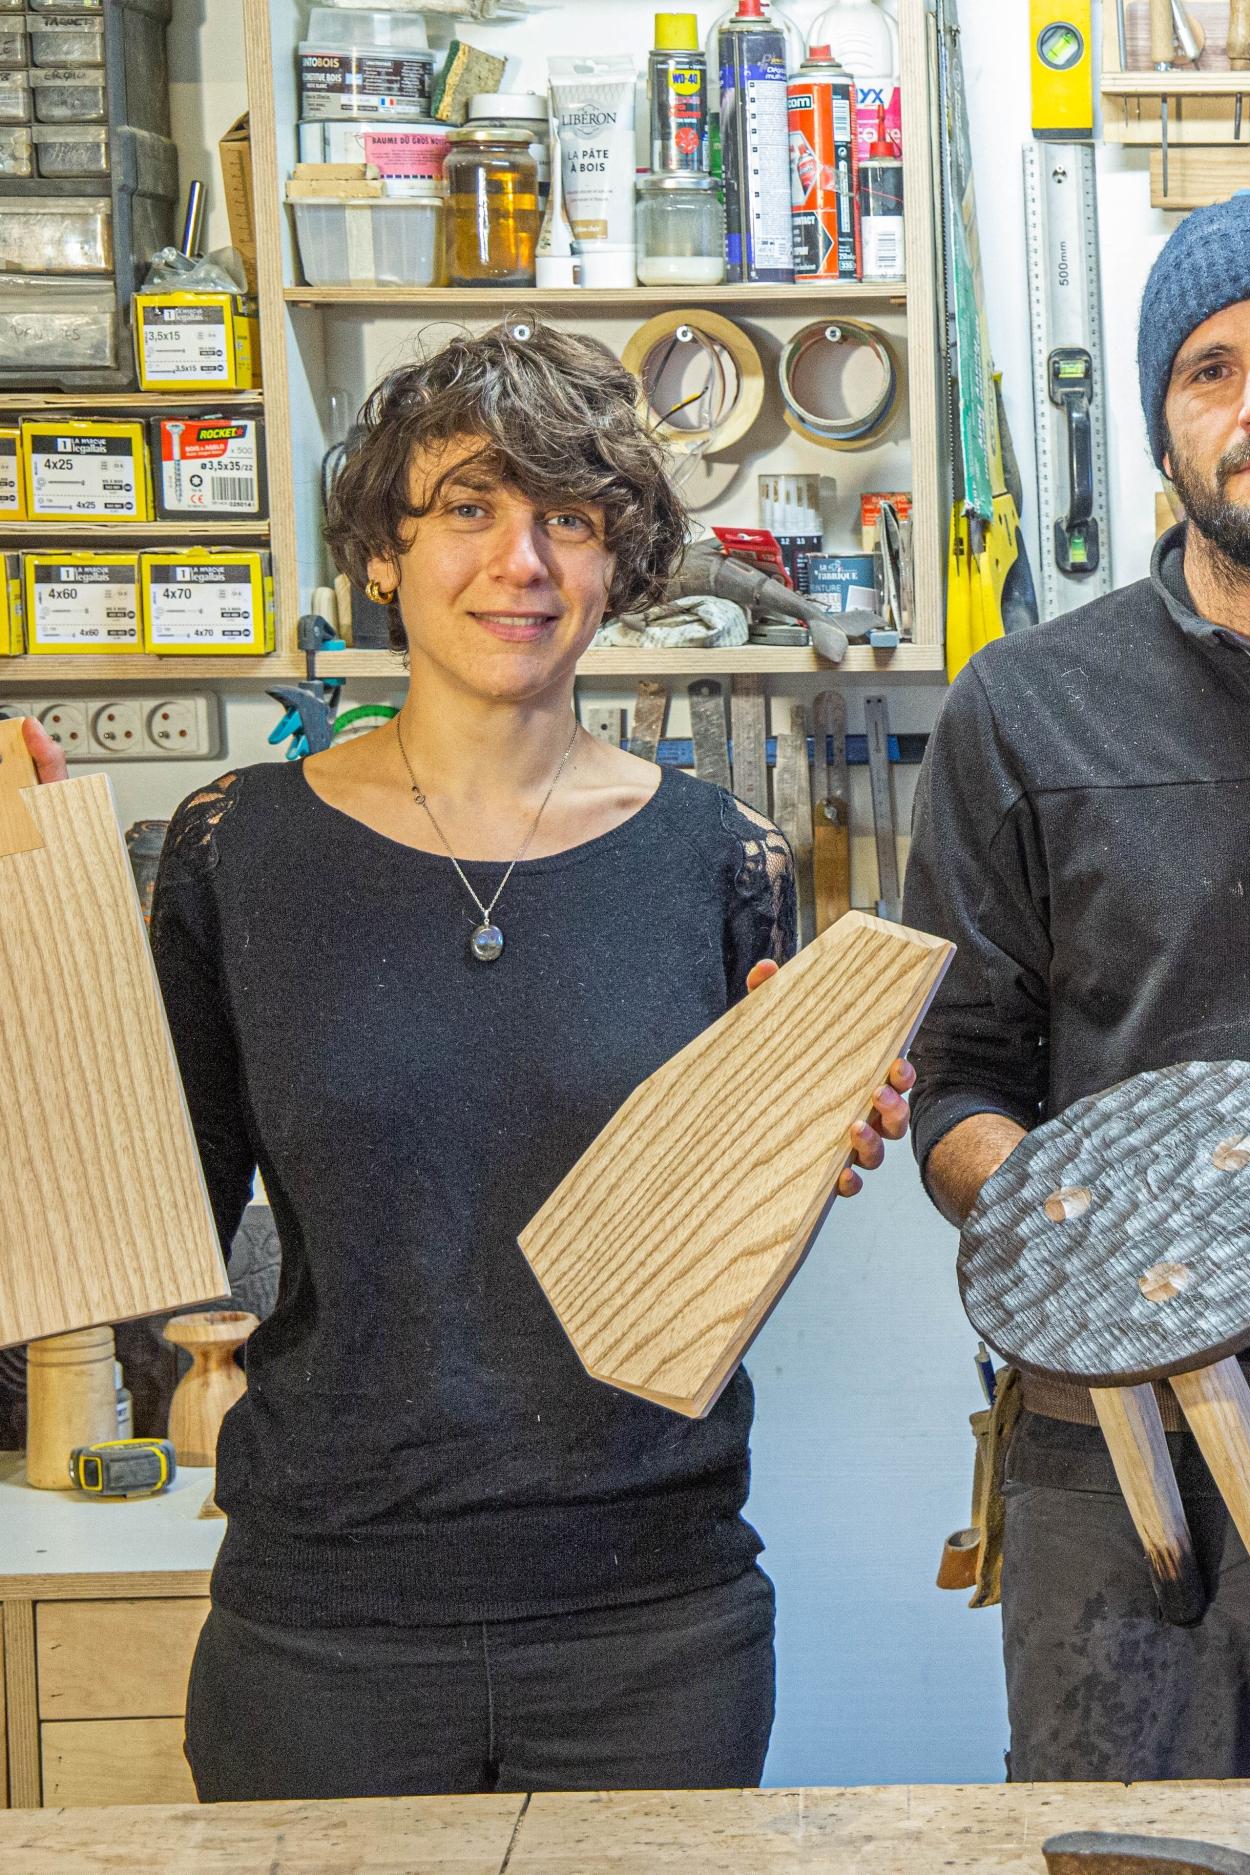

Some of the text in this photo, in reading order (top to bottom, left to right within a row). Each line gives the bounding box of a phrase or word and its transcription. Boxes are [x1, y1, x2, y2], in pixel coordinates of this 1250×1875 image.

[672, 73, 698, 84] WD-40
[856, 88, 883, 103] YX
[562, 111, 617, 126] LIBÉRON
[372, 136, 398, 145] BAUME
[567, 148, 609, 161] LA PÂTE
[580, 162, 606, 173] BOIS
[1058, 241, 1070, 286] 500mm
[148, 331, 181, 342] 3,5x15
[175, 365, 197, 373] 3,5x15
[199, 427, 237, 440] ROCKET
[44, 458, 74, 471] 4x25
[76, 501, 97, 510] 4x25
[48, 588, 78, 600] 4x60
[163, 588, 192, 600] 4x70
[79, 628, 100, 637] 4x60
[194, 629, 214, 637] 4x70
